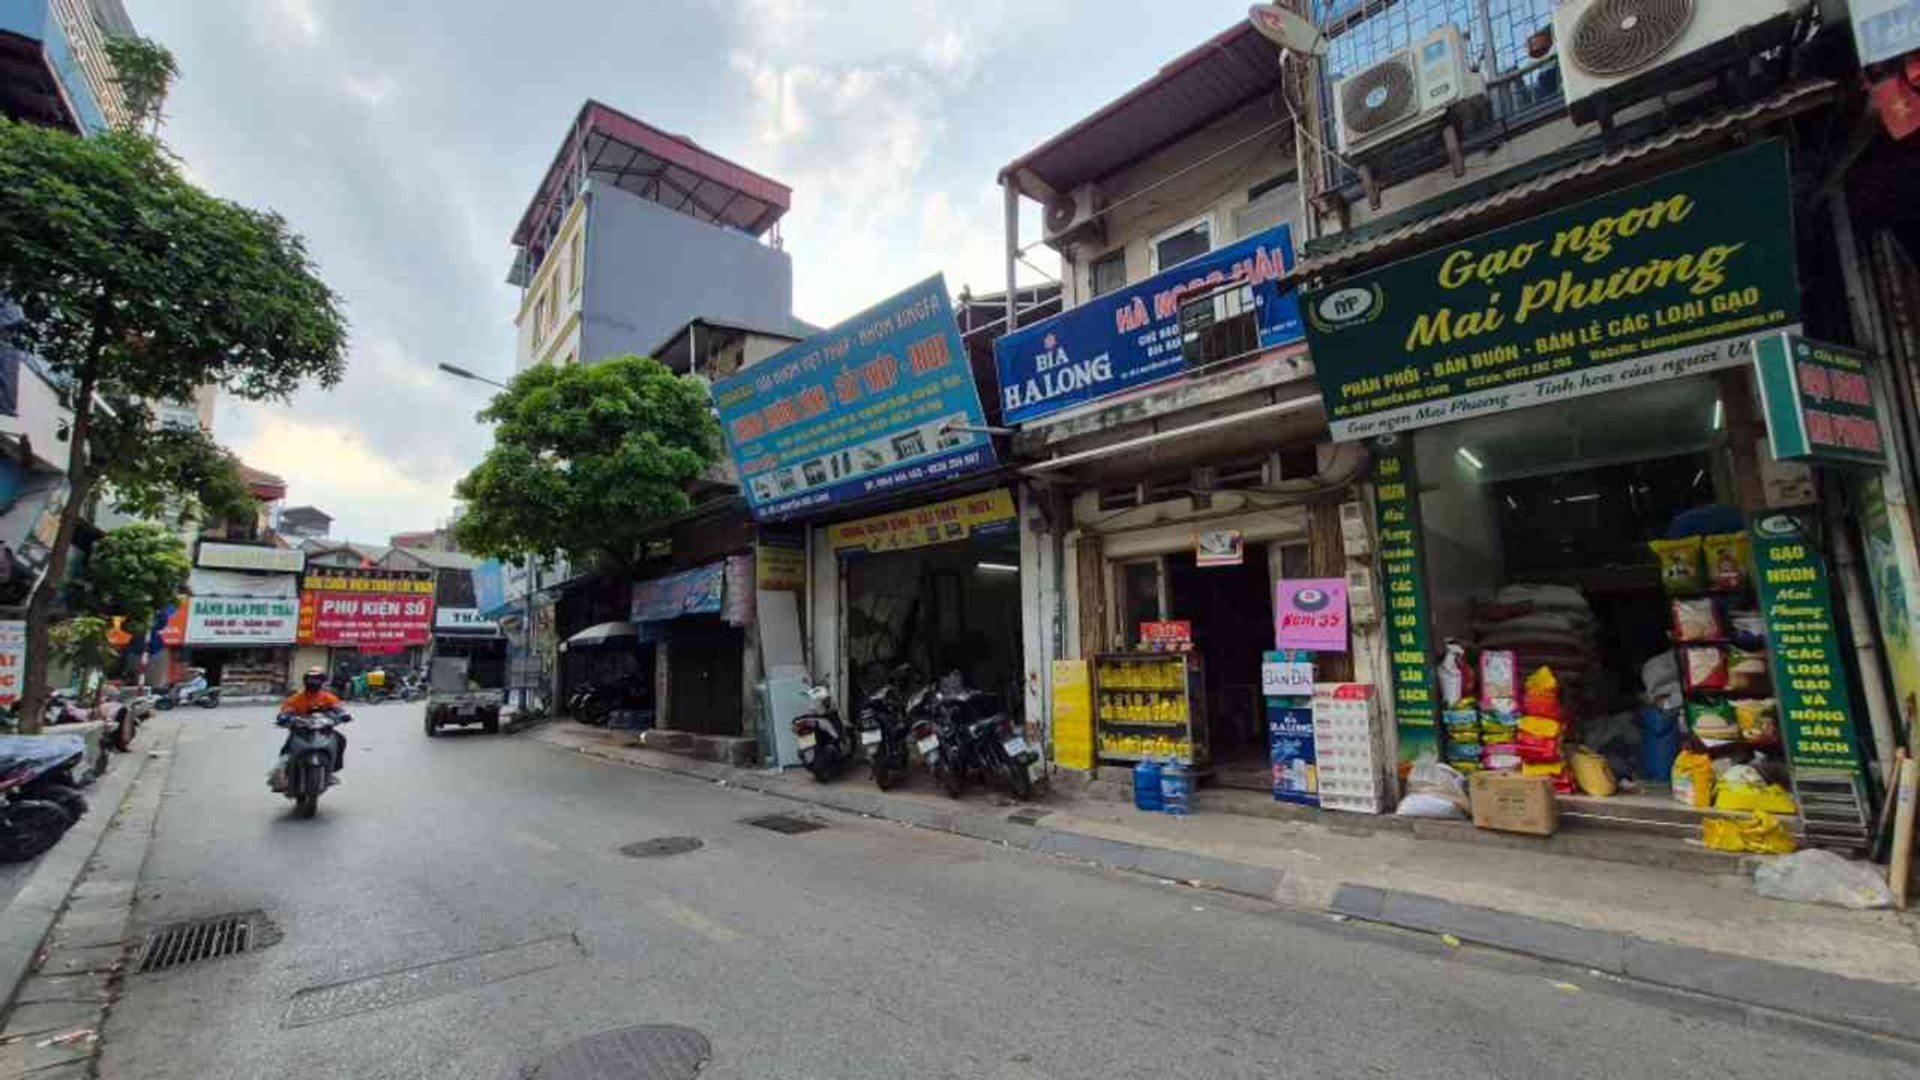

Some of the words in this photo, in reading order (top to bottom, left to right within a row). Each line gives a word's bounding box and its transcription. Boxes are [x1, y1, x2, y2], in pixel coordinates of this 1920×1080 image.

[1438, 240, 1543, 290] Gạo
[1551, 193, 1696, 261] ngon
[1405, 293, 1504, 351] Mai
[1513, 241, 1746, 327] Phương
[1035, 347, 1070, 373] BIA
[1342, 377, 1381, 398] PHÂN
[1383, 367, 1419, 388] PHỐI
[1473, 343, 1519, 369] BUÔN
[1608, 308, 1651, 338] CÁC
[1656, 299, 1705, 325] LOẠI
[1711, 287, 1760, 314] GẠO
[1004, 352, 1113, 412] HALONG
[1765, 567, 1818, 584] NGON
[1319, 612, 1341, 628] 35
